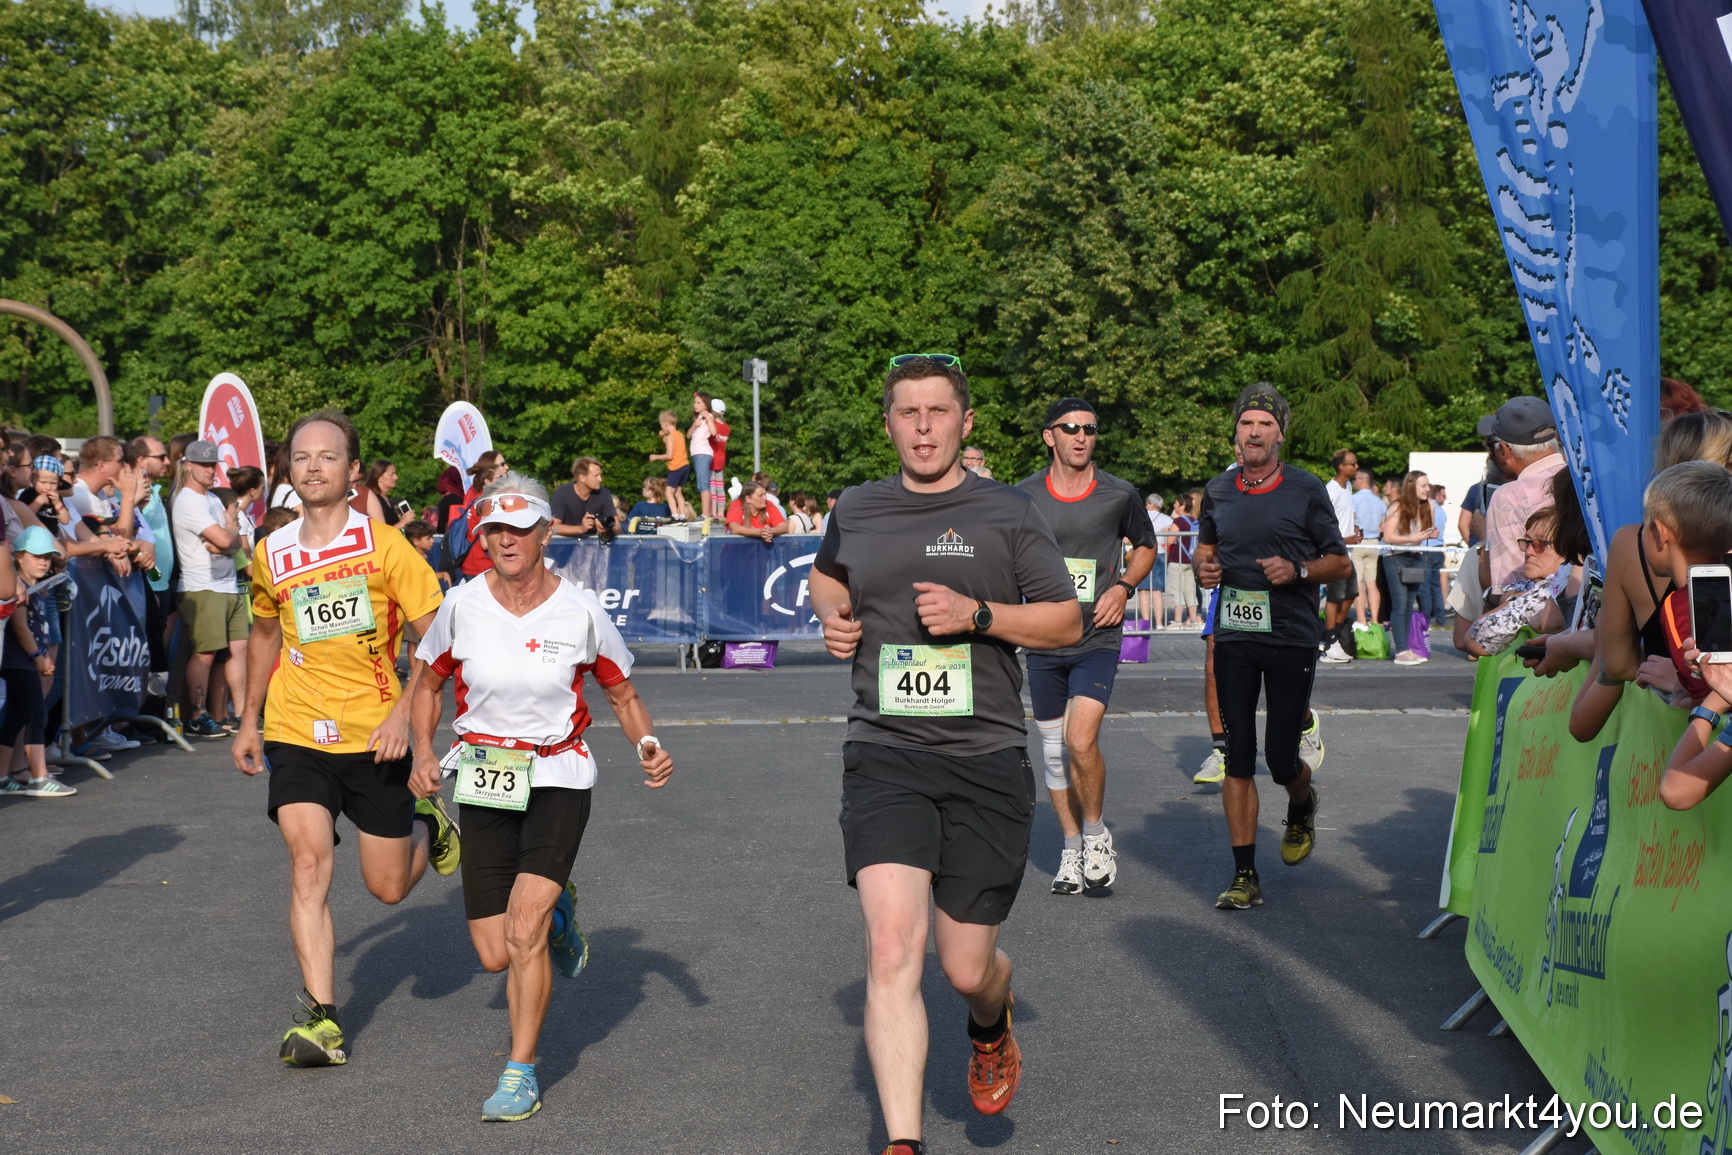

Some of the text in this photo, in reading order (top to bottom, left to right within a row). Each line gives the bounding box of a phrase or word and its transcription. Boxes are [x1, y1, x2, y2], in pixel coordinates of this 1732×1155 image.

[926, 545, 975, 553] BURKHARDT
[304, 597, 358, 625] 1667
[1226, 603, 1263, 620] 1486
[329, 618, 360, 628] Maximilian
[544, 640, 576, 649] Bayerisches
[897, 671, 951, 696] 404
[931, 697, 955, 705] Holger
[474, 767, 516, 792] 373
